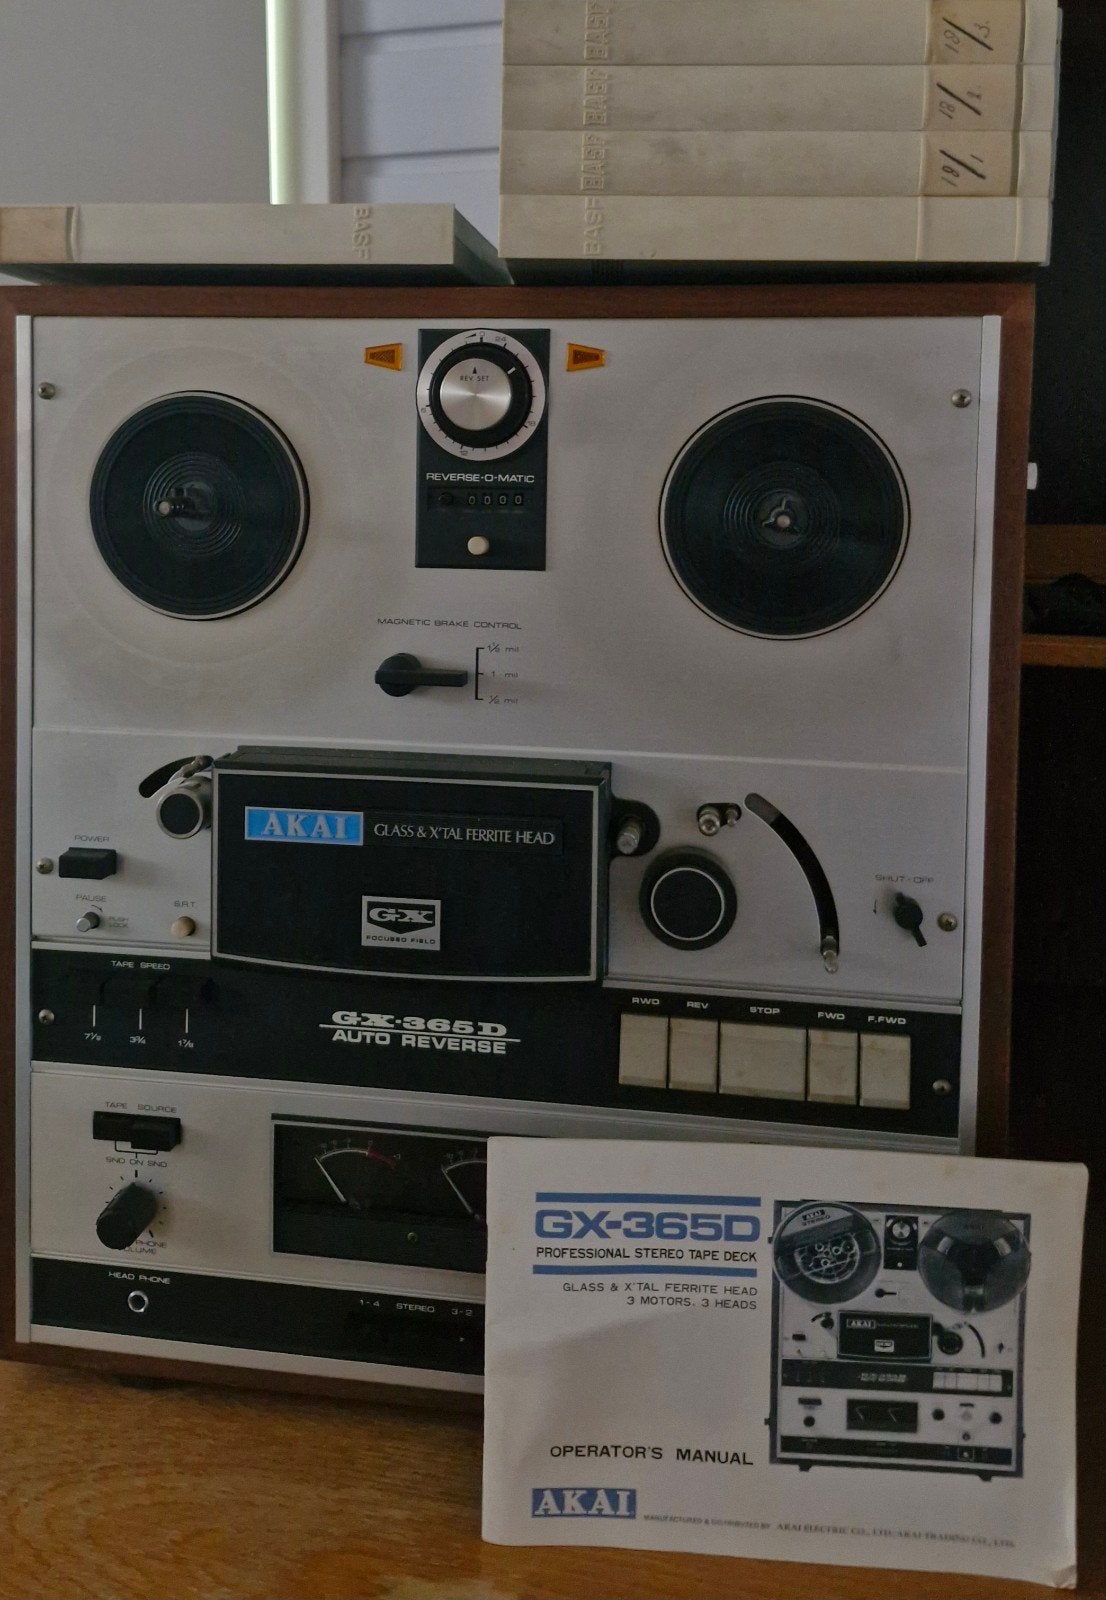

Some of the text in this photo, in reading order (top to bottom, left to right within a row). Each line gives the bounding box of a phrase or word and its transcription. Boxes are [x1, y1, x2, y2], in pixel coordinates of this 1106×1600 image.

[584, 1, 608, 60] BASF
[583, 66, 607, 125] BASF
[581, 132, 605, 190] BASF
[583, 195, 602, 256] BASF
[352, 205, 371, 261] BASF
[477, 375, 489, 383] SET
[426, 472, 535, 483] REVERSE-O-MATIC
[377, 618, 522, 630] MAGNETIC BRAKE CONTROL
[505, 644, 519, 653] mil
[504, 697, 518, 705] mil
[261, 812, 349, 839] AKAI
[74, 834, 110, 842] POWER
[374, 824, 556, 845] GLASS & X'TAL FERRITE HEAD
[76, 894, 107, 903] PAUSE
[366, 935, 407, 943] FOCUSED
[111, 960, 171, 971] TAPE SPEED
[632, 996, 660, 1005] RWD
[686, 1001, 709, 1009] REV
[750, 1006, 780, 1015] STOP
[817, 1011, 845, 1020] FWD
[867, 1015, 907, 1025] F.FWD
[332, 1029, 507, 1054] AUTO REVERSE
[105, 1101, 128, 1109] TAPE
[137, 1103, 178, 1113] SOURCE
[105, 1156, 125, 1164] SND
[535, 1209, 761, 1242] GX-365D
[536, 1247, 758, 1262] PROFESSIONAL STEREO TAPE DECK
[108, 1271, 170, 1284] HEAD PHONE
[562, 1282, 758, 1296] GLASS & X'TAL FERRITE HEAD
[396, 1302, 435, 1313] STEREO
[627, 1296, 635, 1305] 3
[701, 1298, 709, 1308] 3
[715, 1299, 757, 1310] HEADS
[550, 1445, 753, 1465] OPERATOR'S MANUAL
[535, 1489, 632, 1516] AKAI
